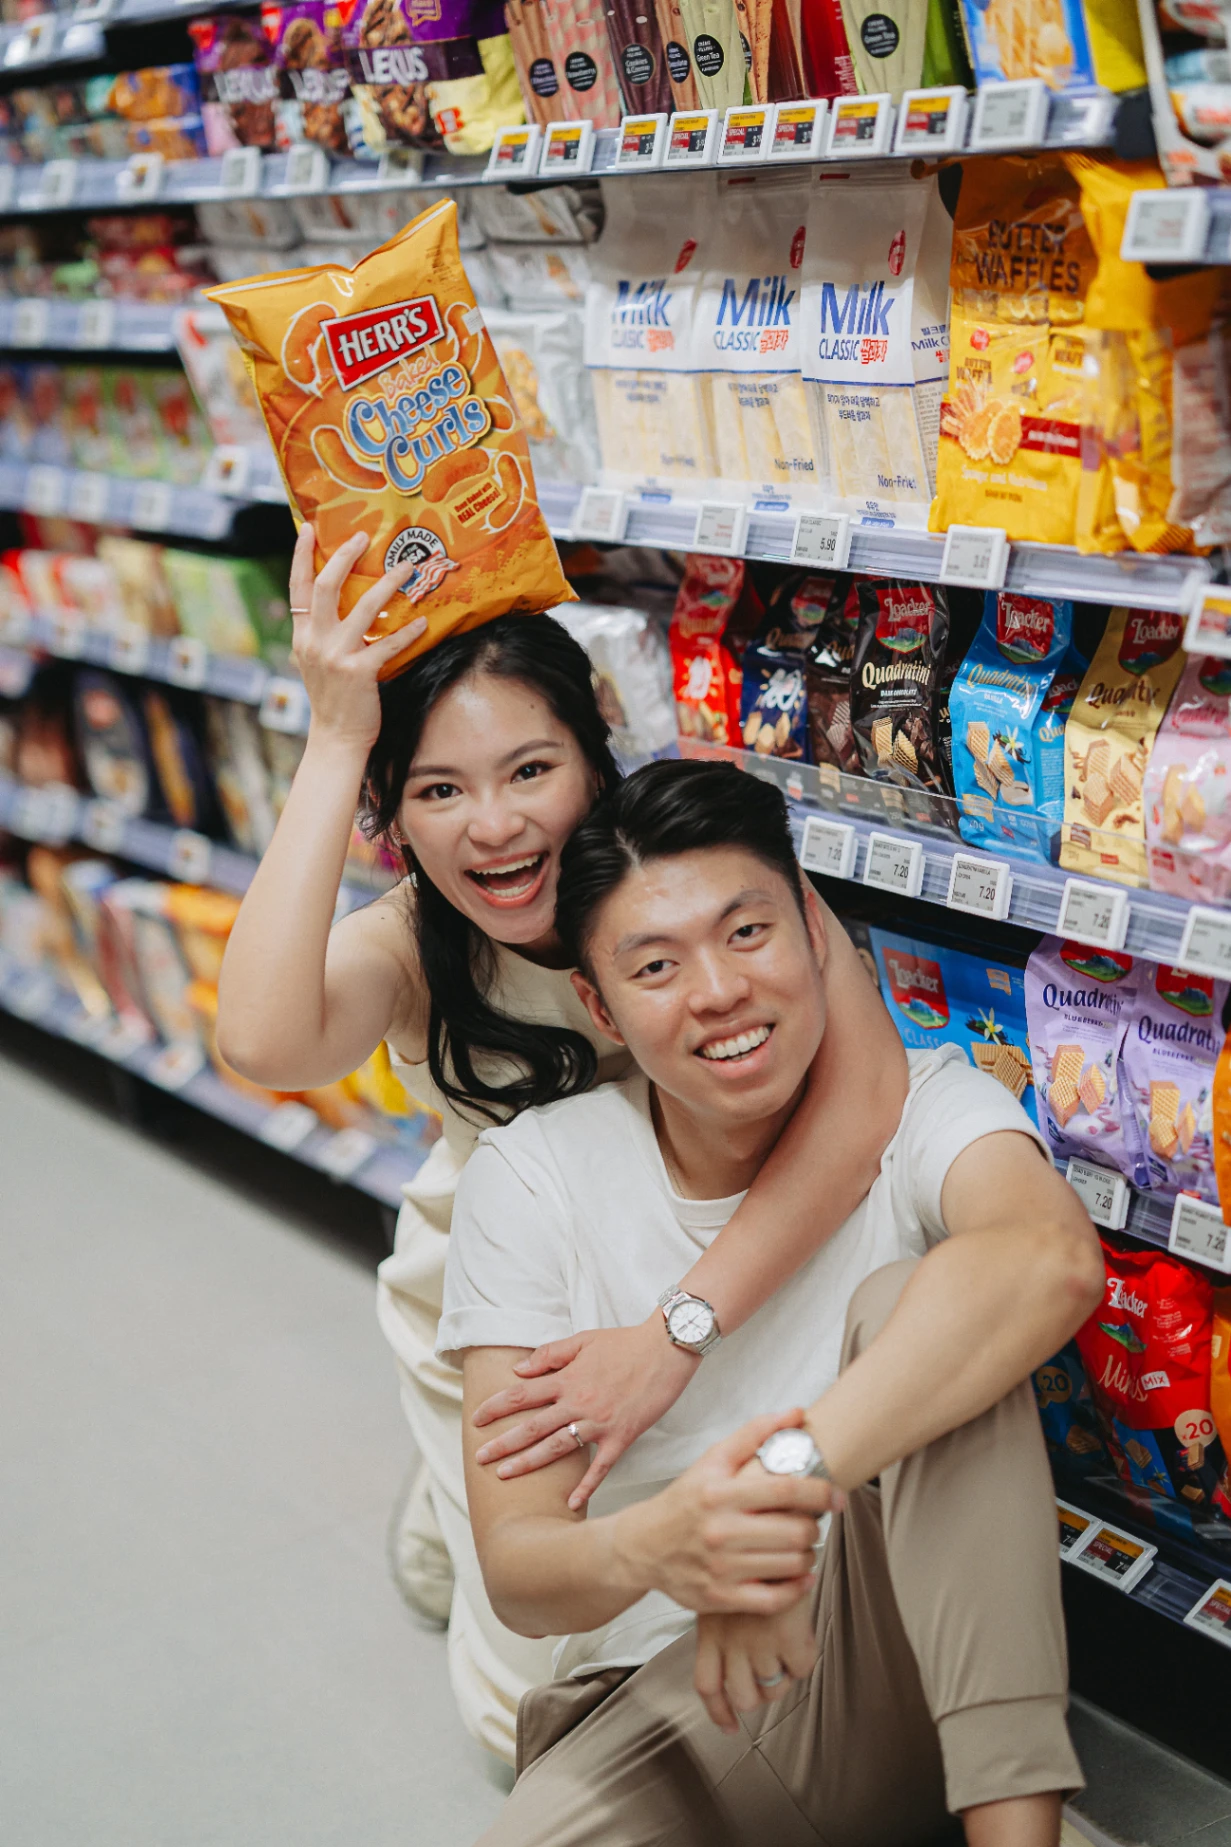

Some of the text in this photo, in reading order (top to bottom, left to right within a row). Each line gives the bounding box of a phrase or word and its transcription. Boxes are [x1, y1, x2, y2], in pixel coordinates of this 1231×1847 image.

[358, 46, 428, 84] LEXUS
[709, 52, 720, 60] Tea
[673, 132, 690, 141] SPECIAL
[727, 127, 746, 137] SPECIAL
[611, 279, 673, 327] Milk
[715, 275, 797, 327] Milk
[820, 280, 896, 336] Milk
[337, 305, 429, 367] HERR'S
[713, 330, 761, 352] CLASSIC
[911, 339, 940, 351] Milk
[818, 338, 860, 361] CLASSIC
[377, 343, 441, 400] Baked
[349, 366, 467, 457] Cheese
[384, 400, 488, 491] Curls
[774, 457, 815, 472] Non-Fried
[457, 508, 477, 525] REAL
[386, 528, 439, 569] AMILY MADE
[820, 537, 837, 551] 5.90
[883, 597, 931, 622] Loacker
[1131, 618, 1180, 644] Loacker
[862, 660, 932, 690] Quadratini
[893, 863, 909, 879] 7.20
[979, 885, 996, 901] 7.20
[888, 958, 939, 993] Loacker
[1095, 1192, 1113, 1210] 7.20
[1181, 1418, 1214, 1441] x20
[1092, 1539, 1114, 1555] SPECIAL
